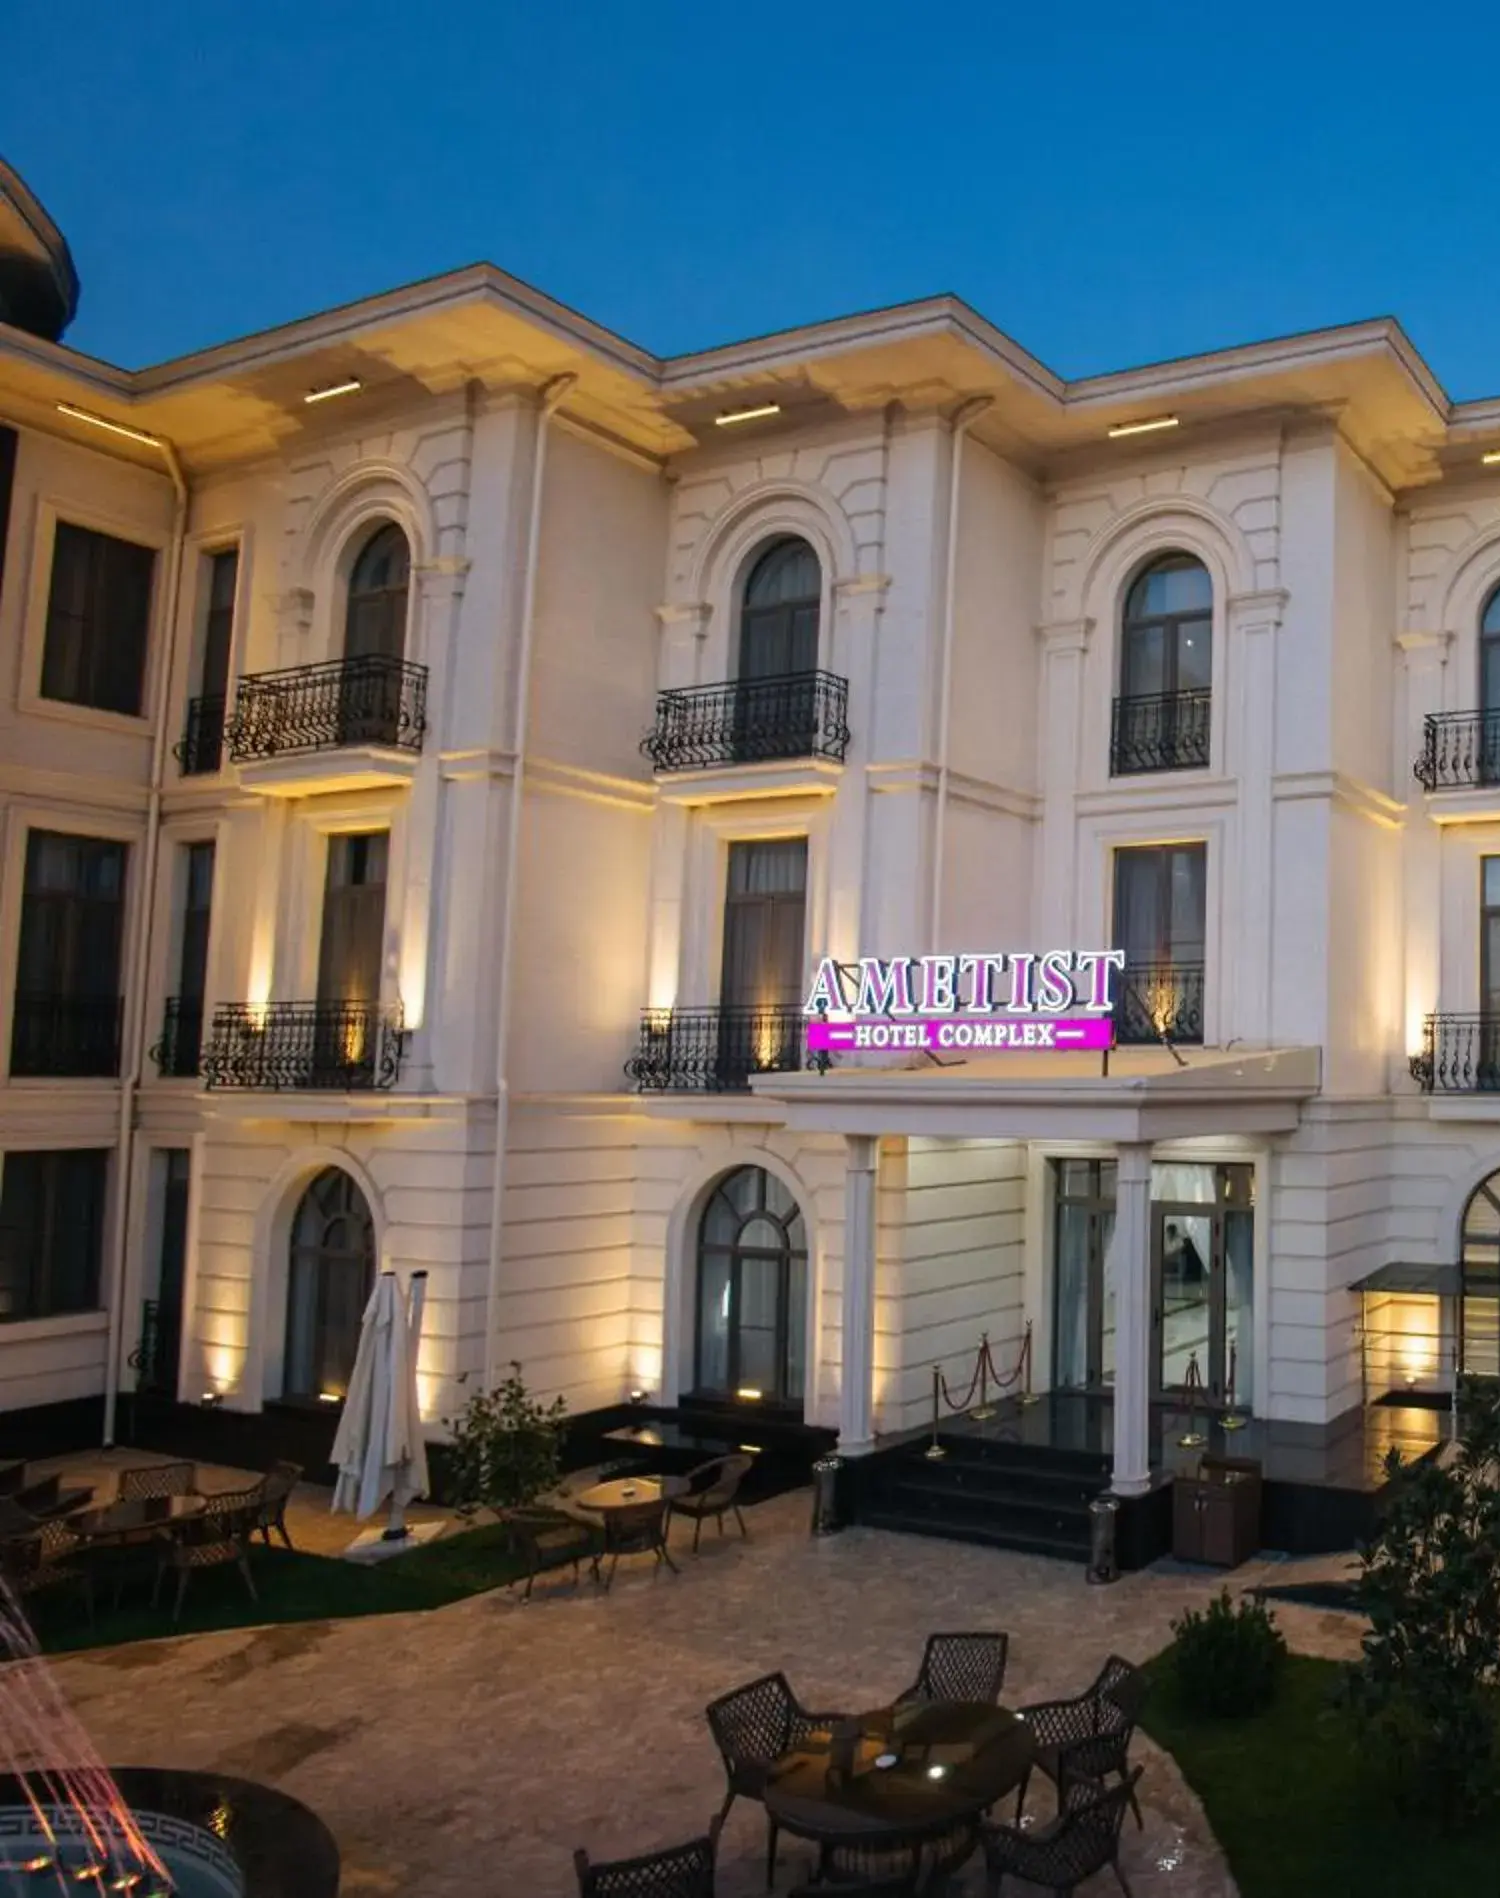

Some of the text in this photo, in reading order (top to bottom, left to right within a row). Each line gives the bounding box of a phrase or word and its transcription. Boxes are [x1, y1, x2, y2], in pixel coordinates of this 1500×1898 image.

[802, 950, 1125, 1015] AMETIST
[853, 1022, 1055, 1048] HOTEL COMPLEX
